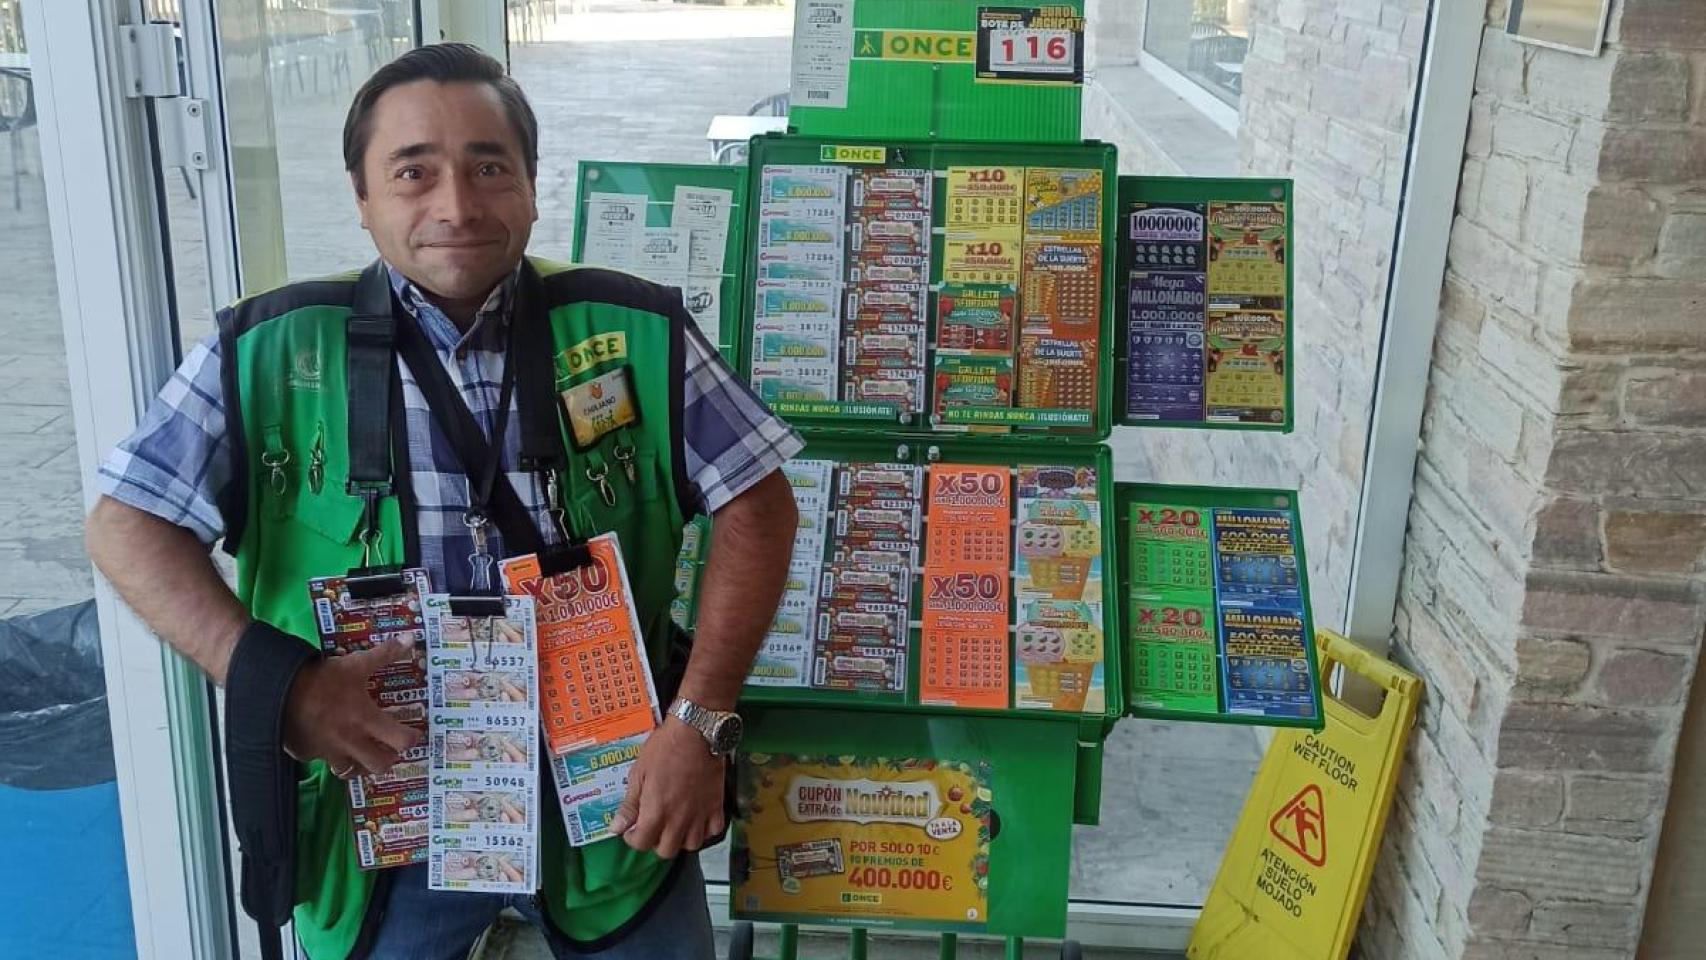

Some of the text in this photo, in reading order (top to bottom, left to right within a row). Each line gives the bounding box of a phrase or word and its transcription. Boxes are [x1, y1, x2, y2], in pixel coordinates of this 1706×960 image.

[889, 36, 974, 56] ONCE
[840, 149, 881, 161] ONCE
[1154, 275, 1185, 290] Mega
[1131, 290, 1203, 305] MILLONARIO
[1131, 310, 1204, 322] 1.000.000€
[570, 337, 619, 369] ONCE
[781, 404, 810, 413] RINDAS
[812, 405, 840, 413] NUNCA
[1216, 515, 1290, 528] MILLONARIO
[549, 592, 619, 623] 1.000.000€
[1225, 614, 1301, 629] MILLONARIO
[484, 656, 524, 667] 86537
[396, 687, 428, 701] 6979
[486, 716, 525, 727] 86537
[1304, 735, 1356, 776] CAUTION
[1293, 741, 1359, 792] WET FLOOR
[485, 776, 525, 787] 50948
[799, 783, 842, 802] CUPÓN
[797, 802, 842, 816] EXTRA de
[845, 788, 931, 819] Navidad
[931, 826, 958, 836] VENTA
[850, 841, 876, 853] POR
[879, 841, 914, 854] SOLO
[850, 855, 924, 866] 10 PREMIOS DE
[848, 868, 953, 891] 400.000€
[1260, 847, 1317, 897] ATENCIÓN
[1264, 866, 1302, 900] SUELO
[852, 894, 880, 902] ONCE
[1256, 878, 1302, 918] MOJADO
